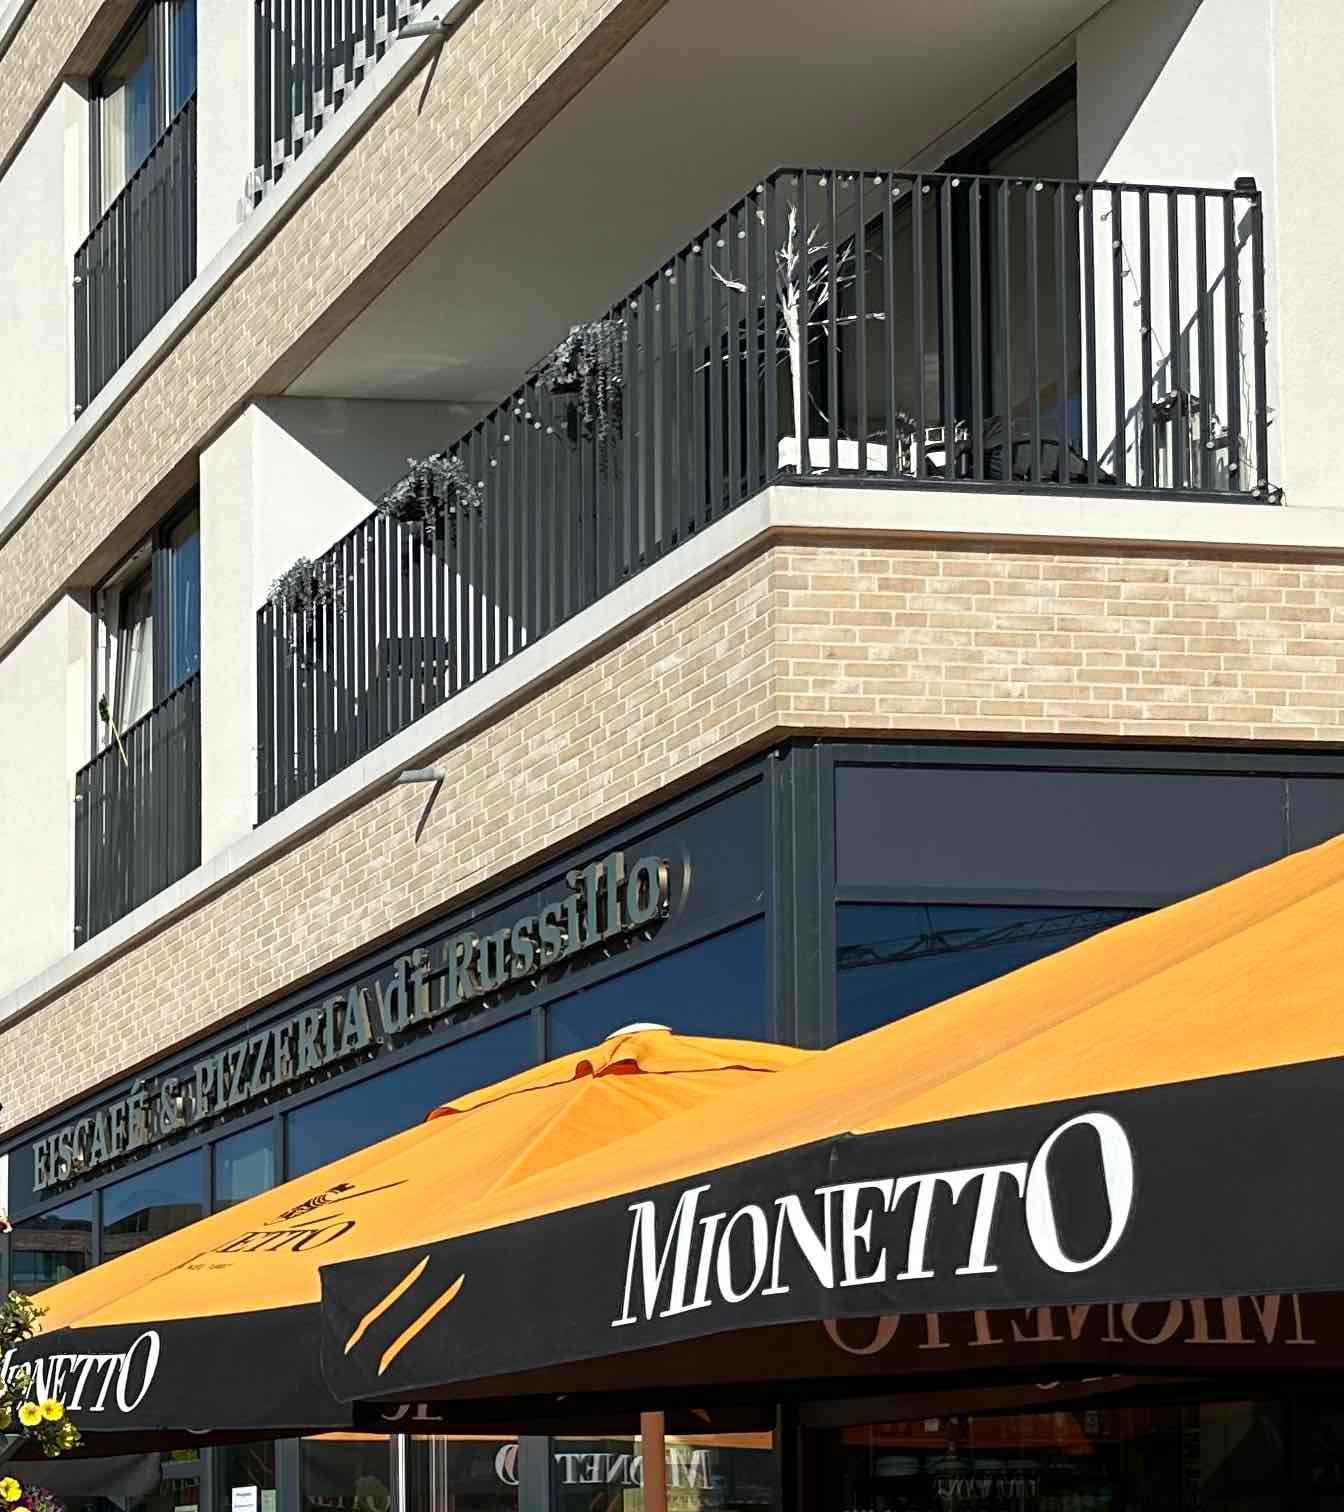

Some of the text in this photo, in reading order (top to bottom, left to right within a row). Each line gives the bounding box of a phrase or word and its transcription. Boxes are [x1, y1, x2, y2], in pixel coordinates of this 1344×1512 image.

[32, 851, 666, 1192] EISCAFÉ & PIZZERIA di Russillo
[611, 1111, 1134, 1328] MIONETTO
